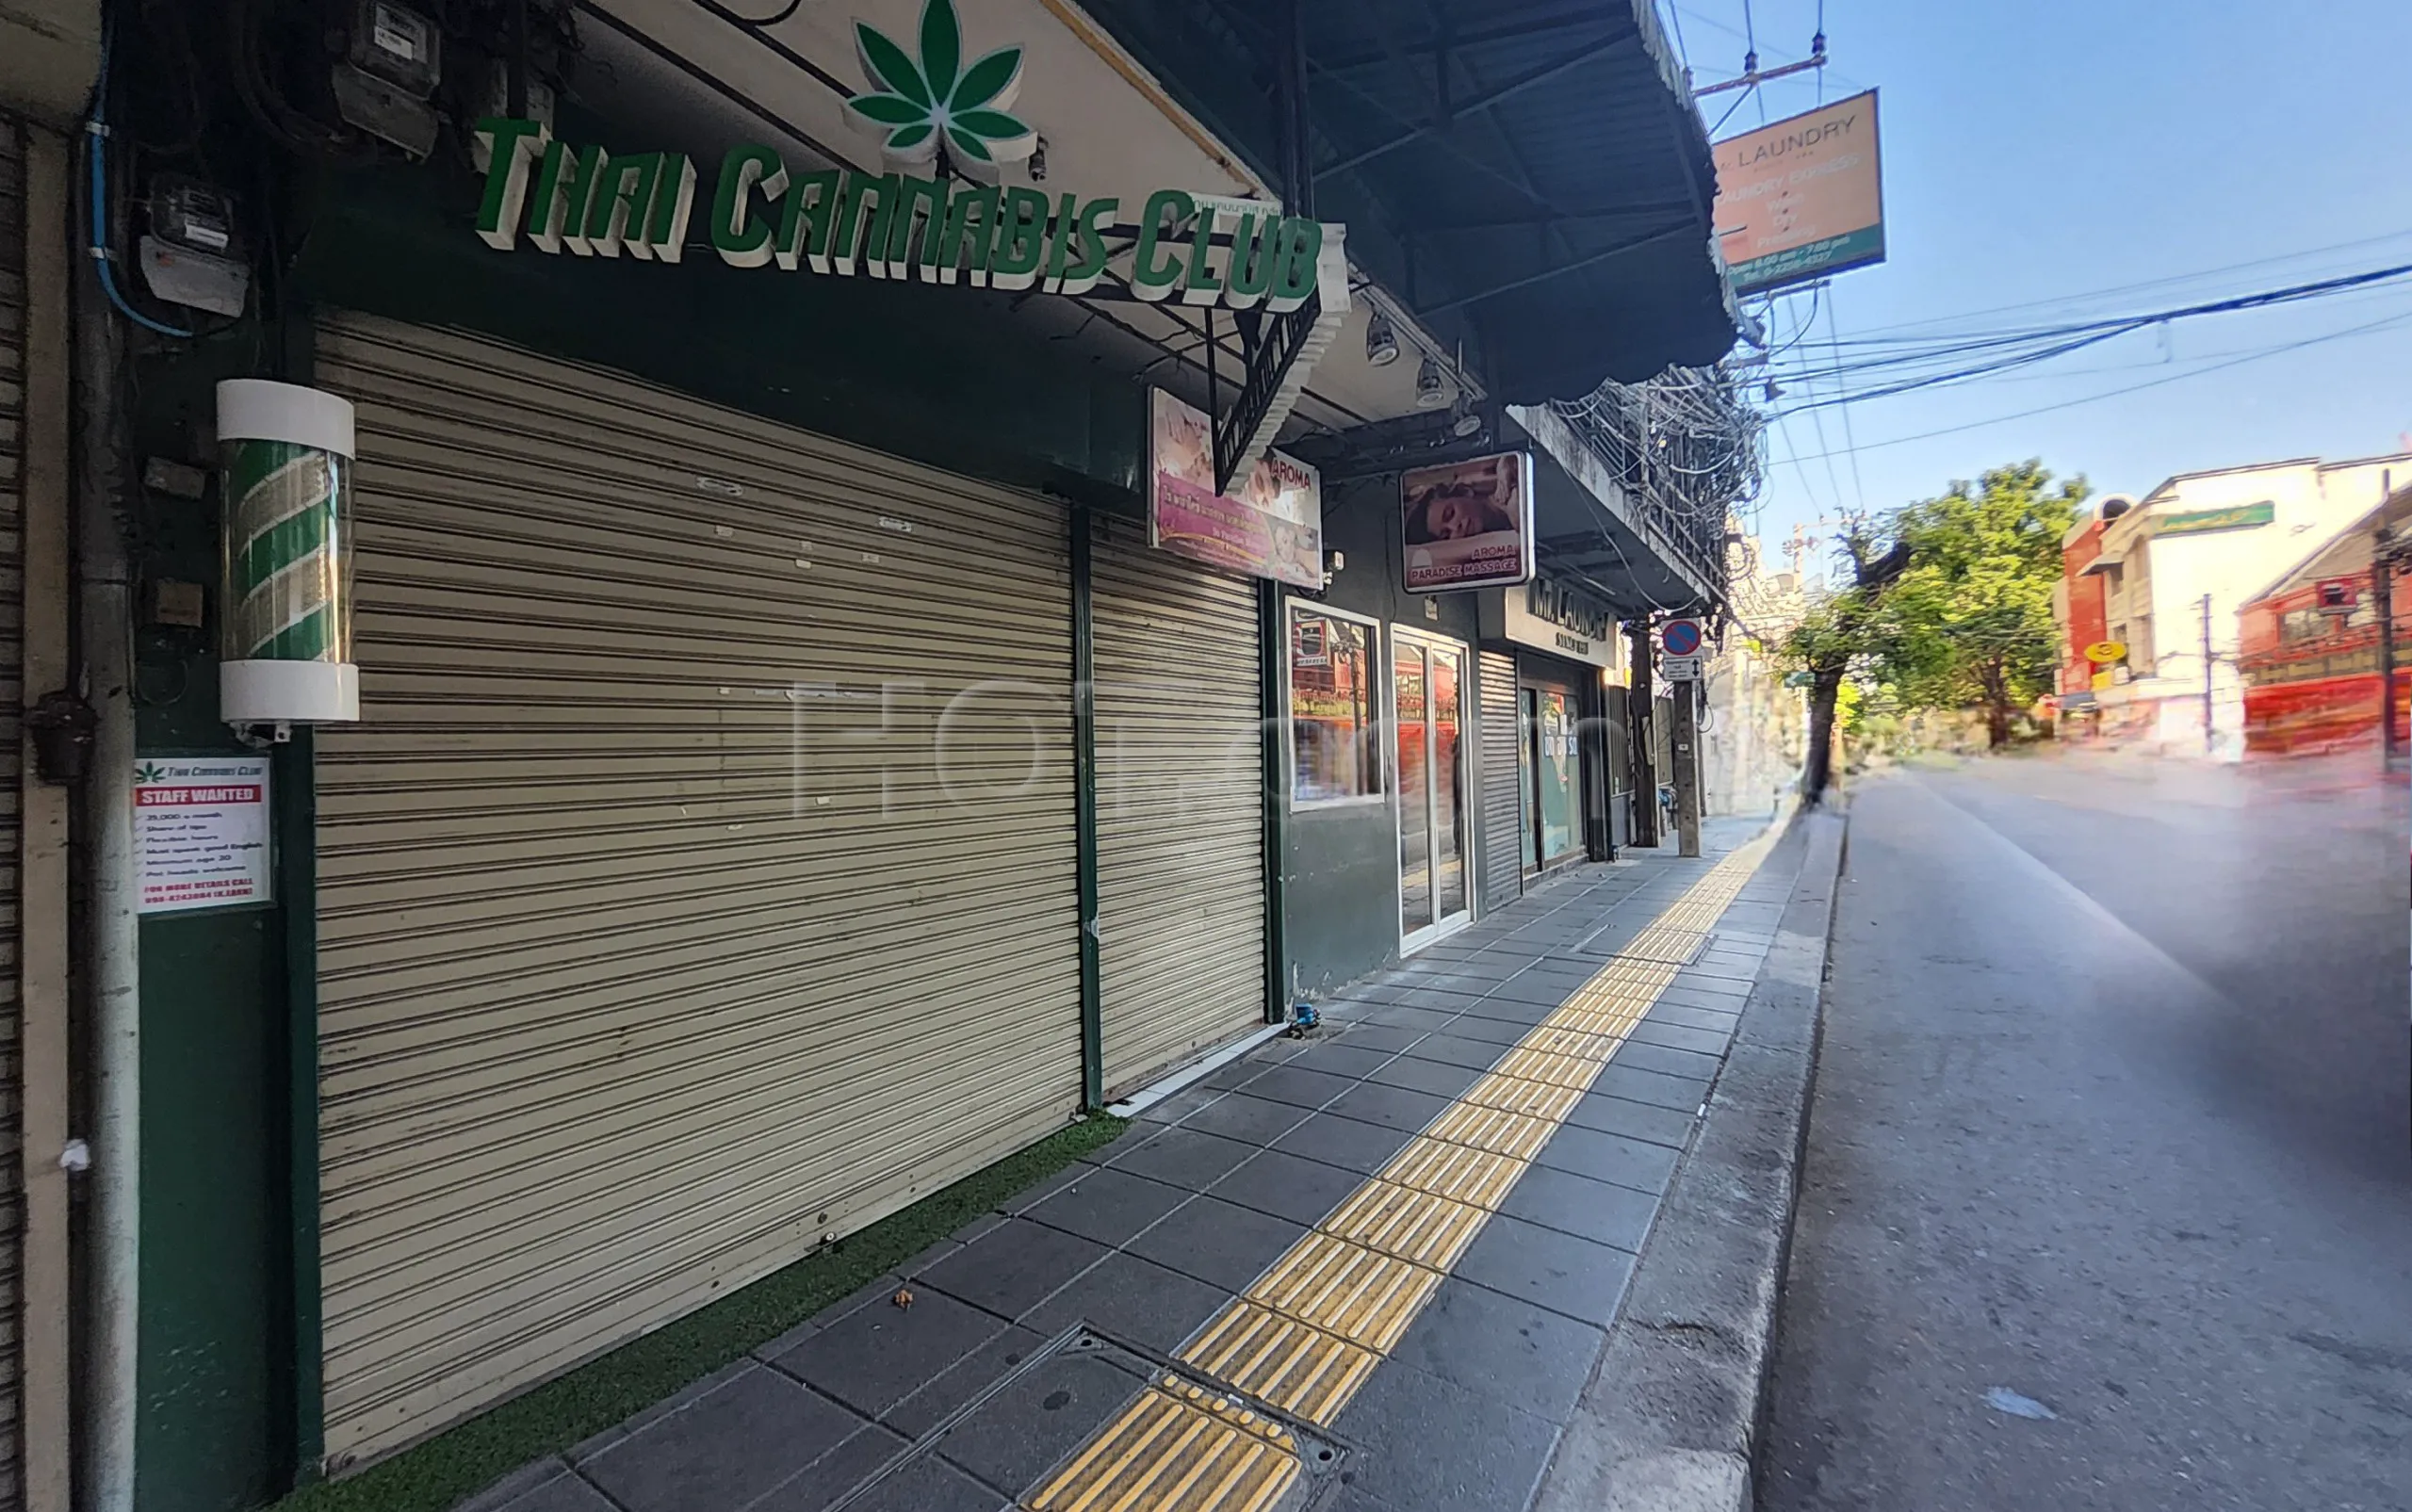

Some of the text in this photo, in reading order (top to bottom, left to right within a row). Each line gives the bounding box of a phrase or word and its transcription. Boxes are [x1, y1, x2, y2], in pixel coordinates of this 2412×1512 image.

[1738, 114, 1856, 168] LAUNDRY
[474, 118, 1322, 313] THAI CANNABIS CLUB
[1272, 459, 1312, 491] AROMA
[1473, 545, 1515, 559] AROMA
[1411, 560, 1516, 580] PARADISE MASSAGE
[142, 788, 253, 804] STAFF WANTED
